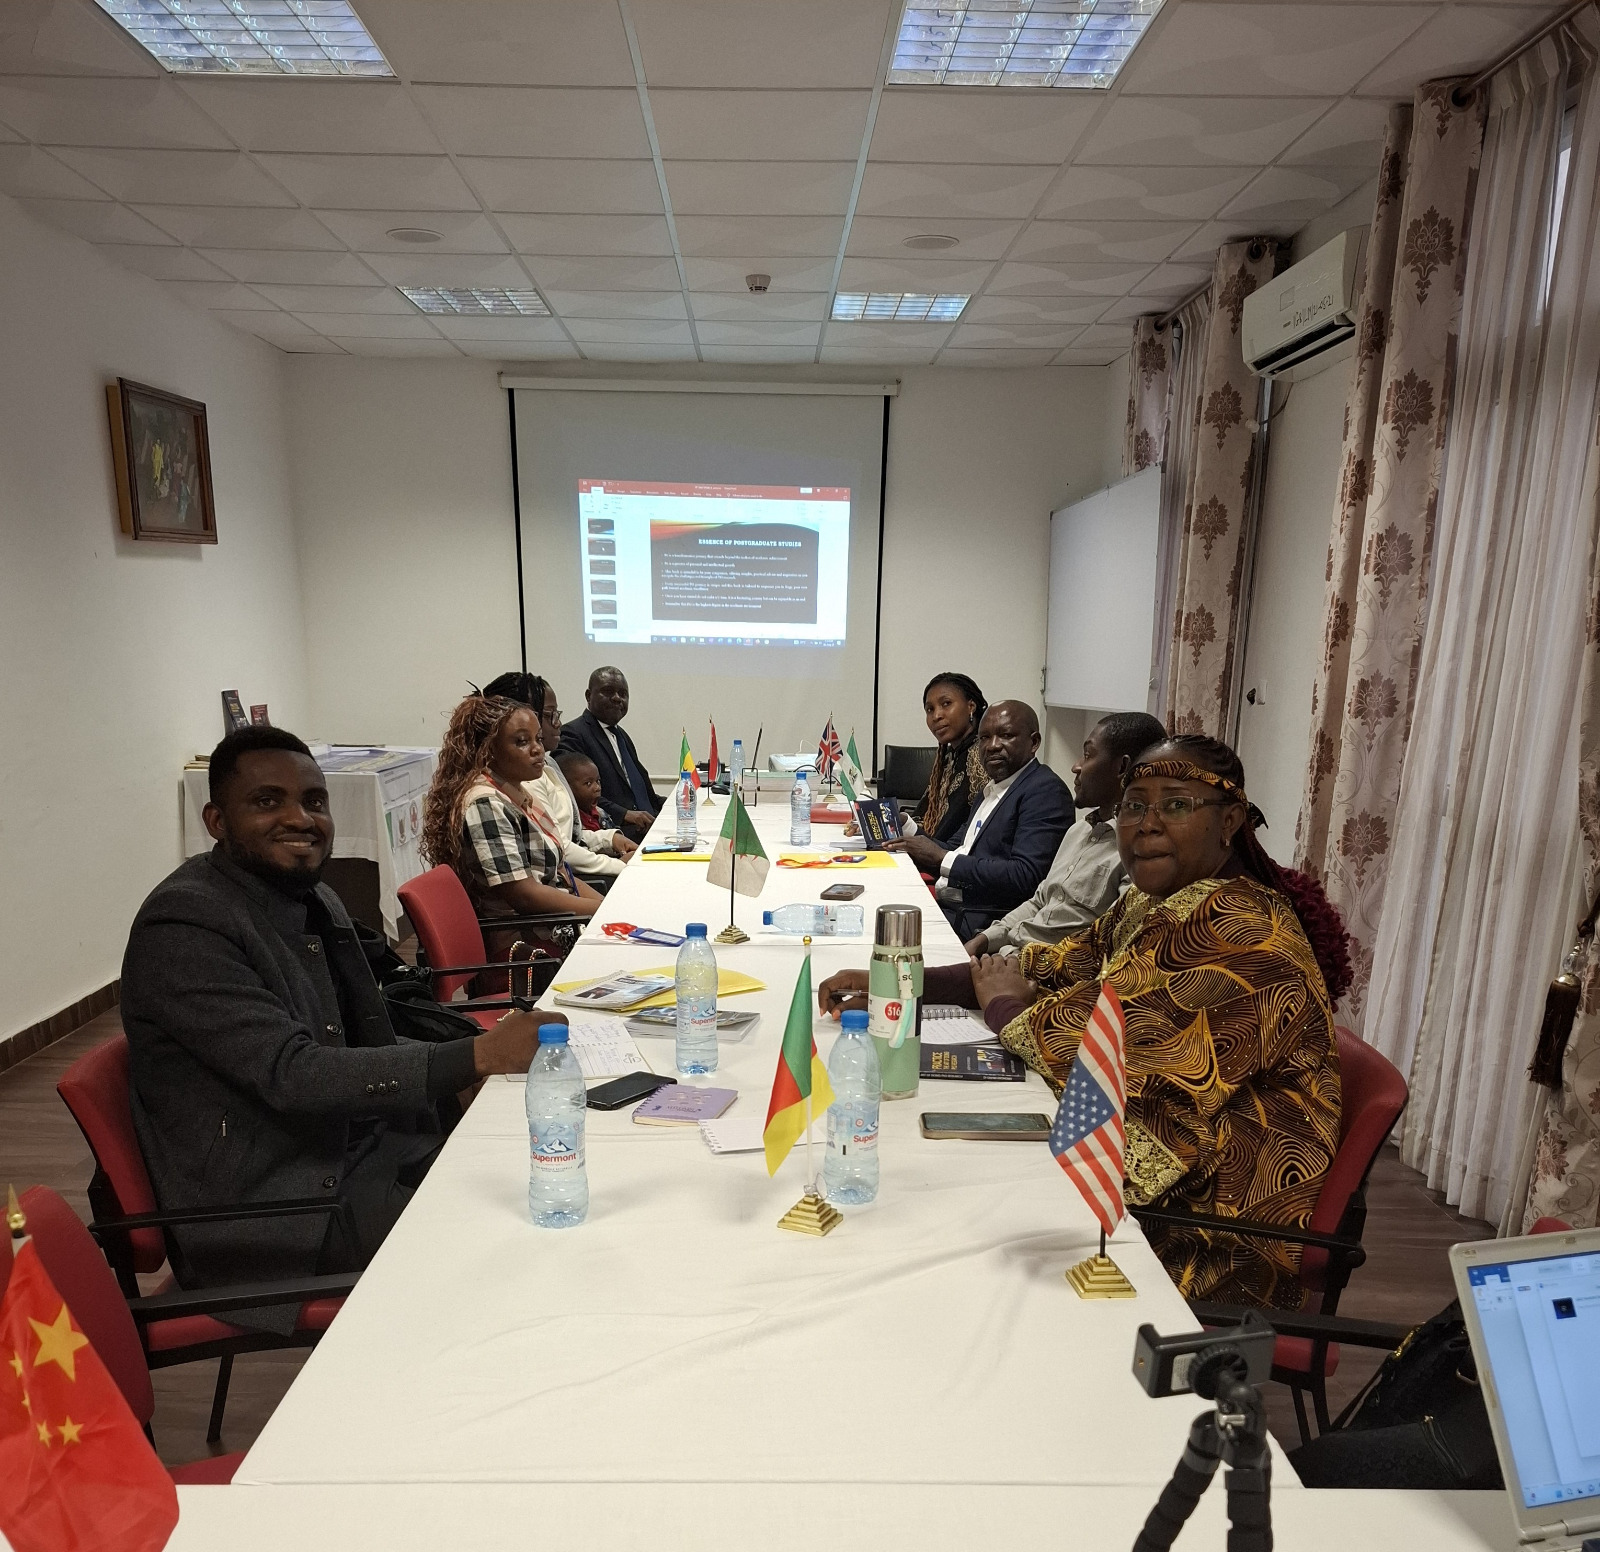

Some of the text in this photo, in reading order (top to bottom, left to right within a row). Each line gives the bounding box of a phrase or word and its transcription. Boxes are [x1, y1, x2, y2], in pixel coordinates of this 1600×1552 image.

[733, 539, 777, 547] POSTGRADUATE
[887, 1006, 901, 1017] 316
[532, 1151, 577, 1163] Supermont
